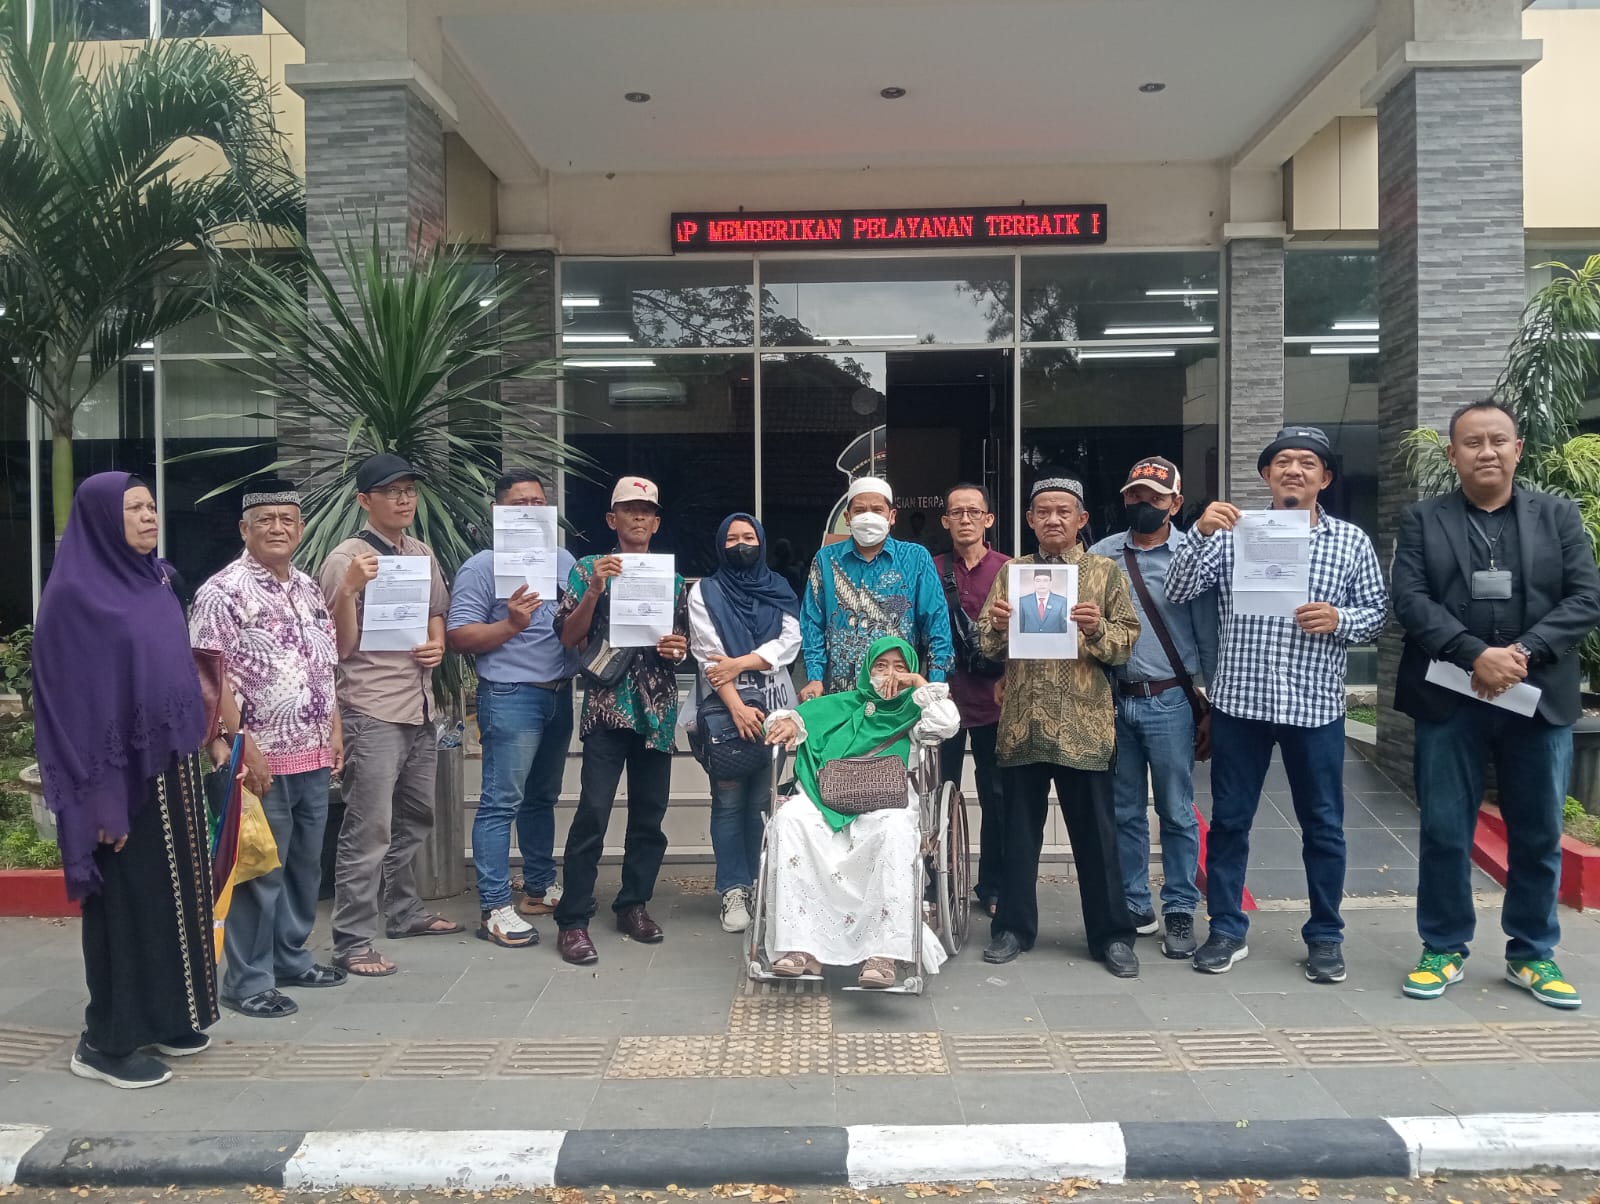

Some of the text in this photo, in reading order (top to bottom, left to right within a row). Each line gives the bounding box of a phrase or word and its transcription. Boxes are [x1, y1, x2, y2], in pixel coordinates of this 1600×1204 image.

[708, 218, 842, 242] MEMBERIKAN
[853, 215, 974, 240] PELAYANAN
[985, 213, 1080, 236] TERBAIK
[917, 496, 945, 509] TERPA
